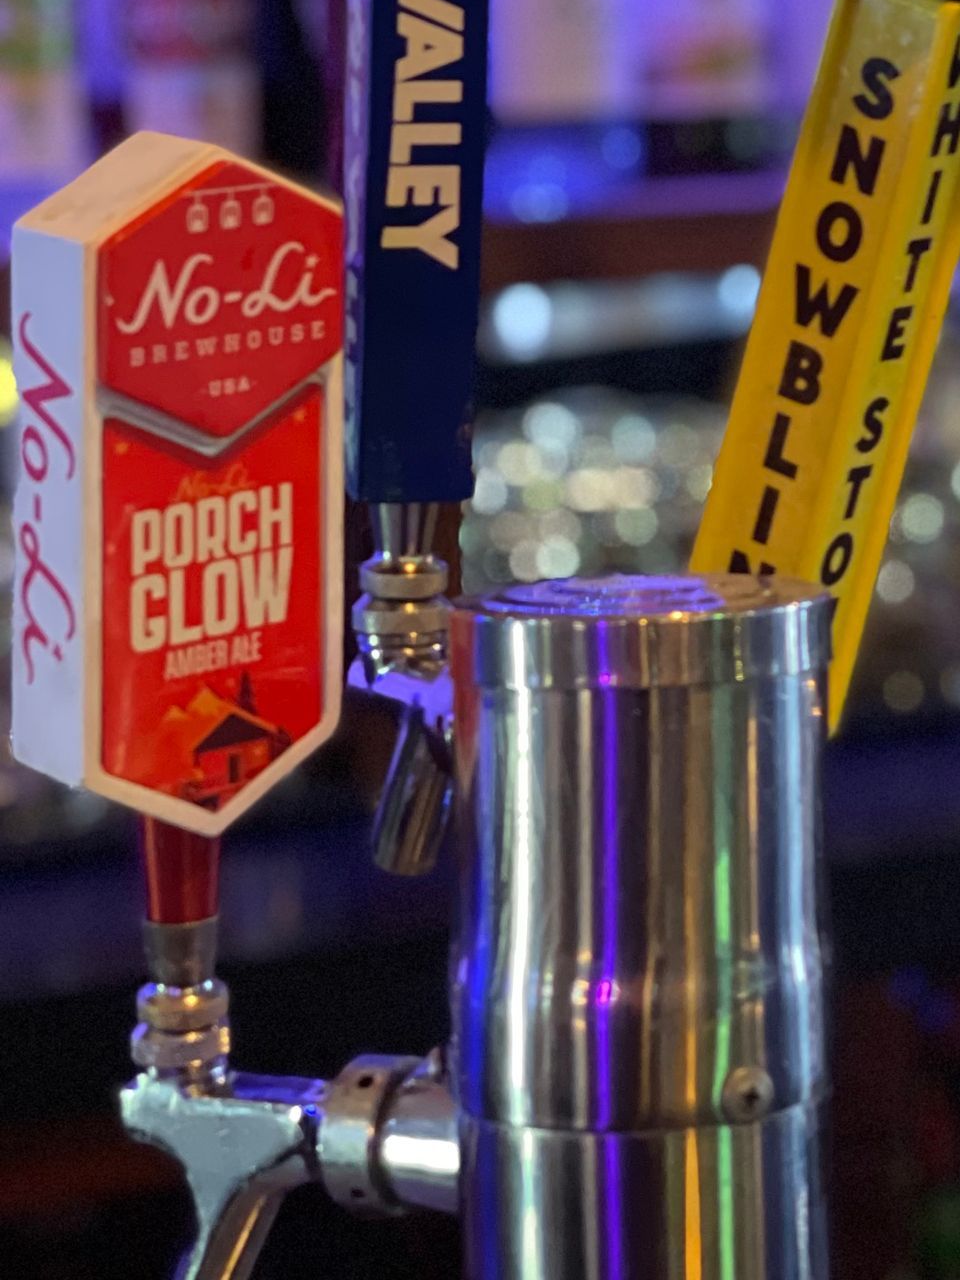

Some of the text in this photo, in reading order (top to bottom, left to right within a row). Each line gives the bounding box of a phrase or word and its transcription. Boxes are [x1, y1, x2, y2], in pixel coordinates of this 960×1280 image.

[115, 241, 337, 334] No-Li
[129, 321, 326, 367] BREWHOUSE
[207, 377, 251, 397] USA
[19, 311, 76, 685] No-Li
[131, 482, 293, 576] PORCH
[821, 397, 890, 610] STO
[131, 546, 293, 653] GLOW
[164, 631, 262, 680] AMBER ALE
